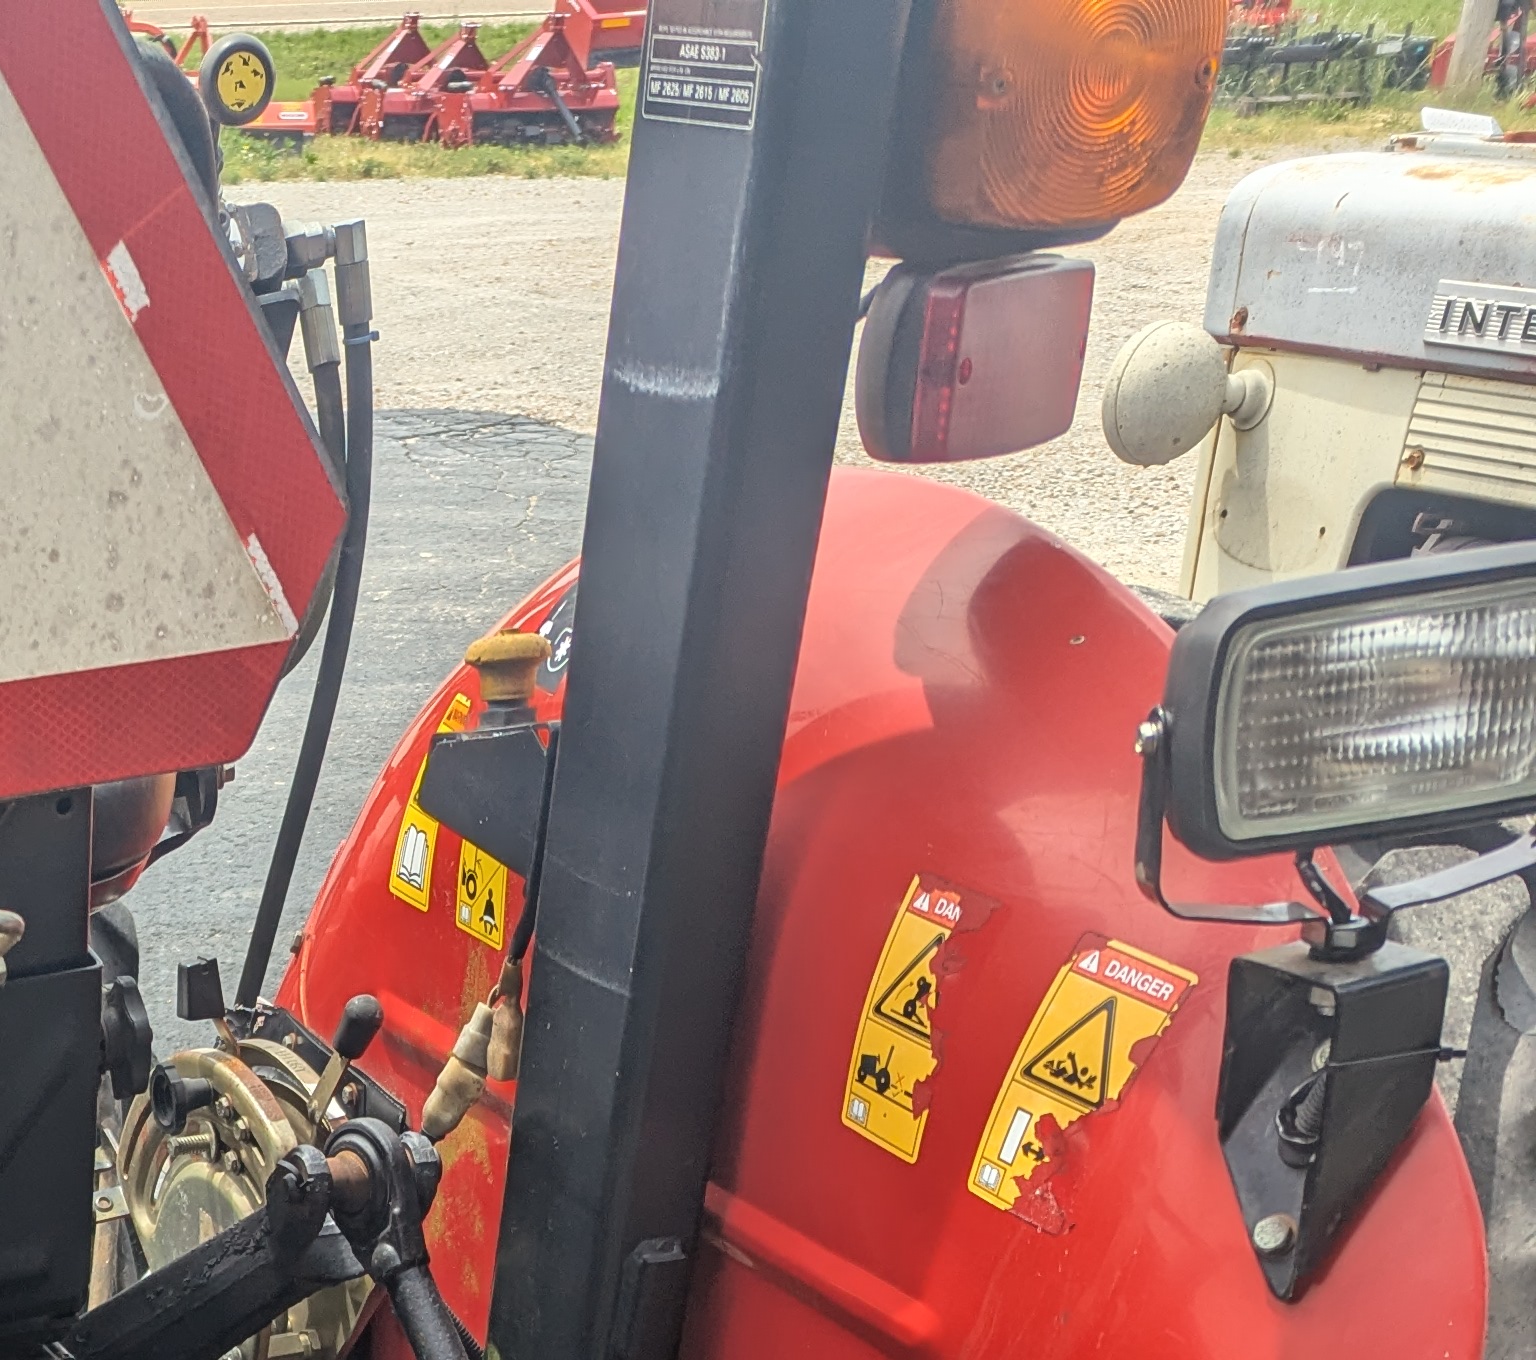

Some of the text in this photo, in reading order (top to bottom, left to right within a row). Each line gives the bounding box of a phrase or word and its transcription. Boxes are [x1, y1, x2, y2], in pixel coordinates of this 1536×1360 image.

[651, 80, 661, 94] MF
[683, 83, 694, 98] MF
[718, 87, 730, 101] MF
[1104, 958, 1175, 1002] DANGER
